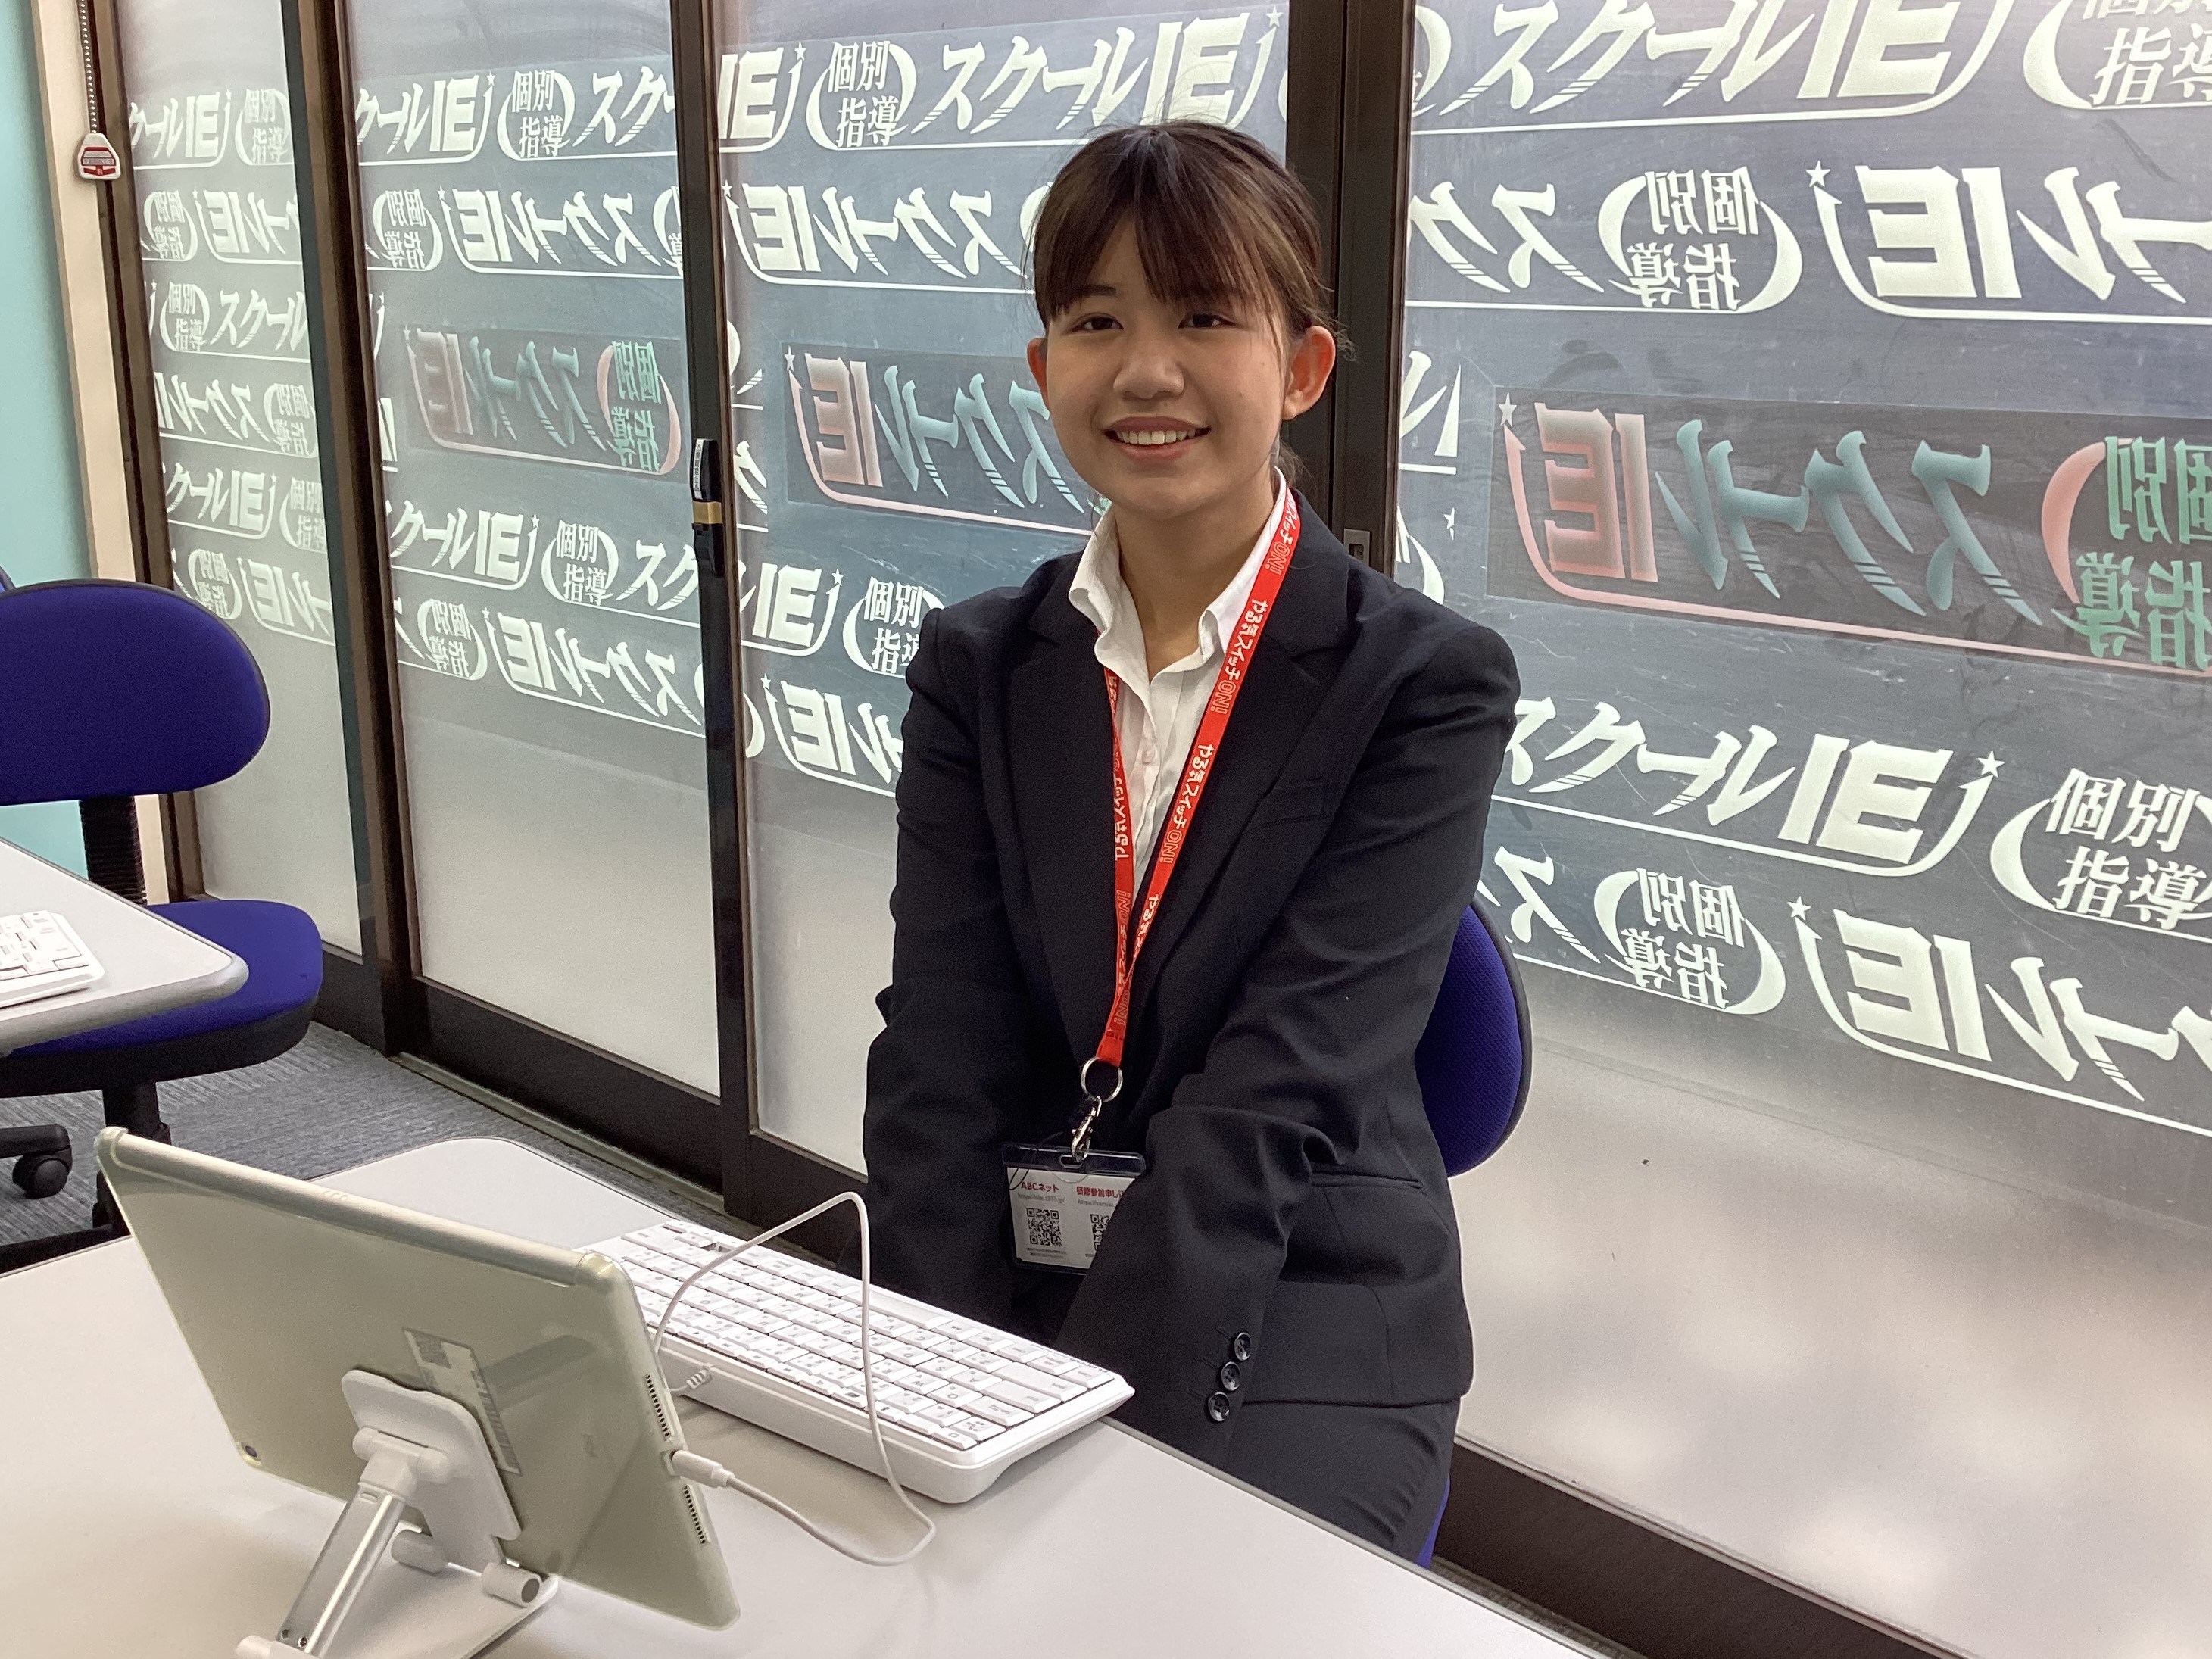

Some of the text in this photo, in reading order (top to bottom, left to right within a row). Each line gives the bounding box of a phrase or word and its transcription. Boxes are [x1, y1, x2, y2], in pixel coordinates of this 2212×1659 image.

[511, 69, 557, 114] 個別
[828, 40, 891, 93] 個別
[910, 12, 1250, 136] スクールIE
[572, 65, 675, 148] スク
[836, 95, 909, 148] 指導
[519, 114, 571, 159] 指導
[556, 519, 600, 563] 個別
[863, 575, 925, 629] 個別
[2045, 767, 2201, 853] 個別
[2051, 844, 2212, 931] 指導
[1021, 1181, 1059, 1193] ABCネット
